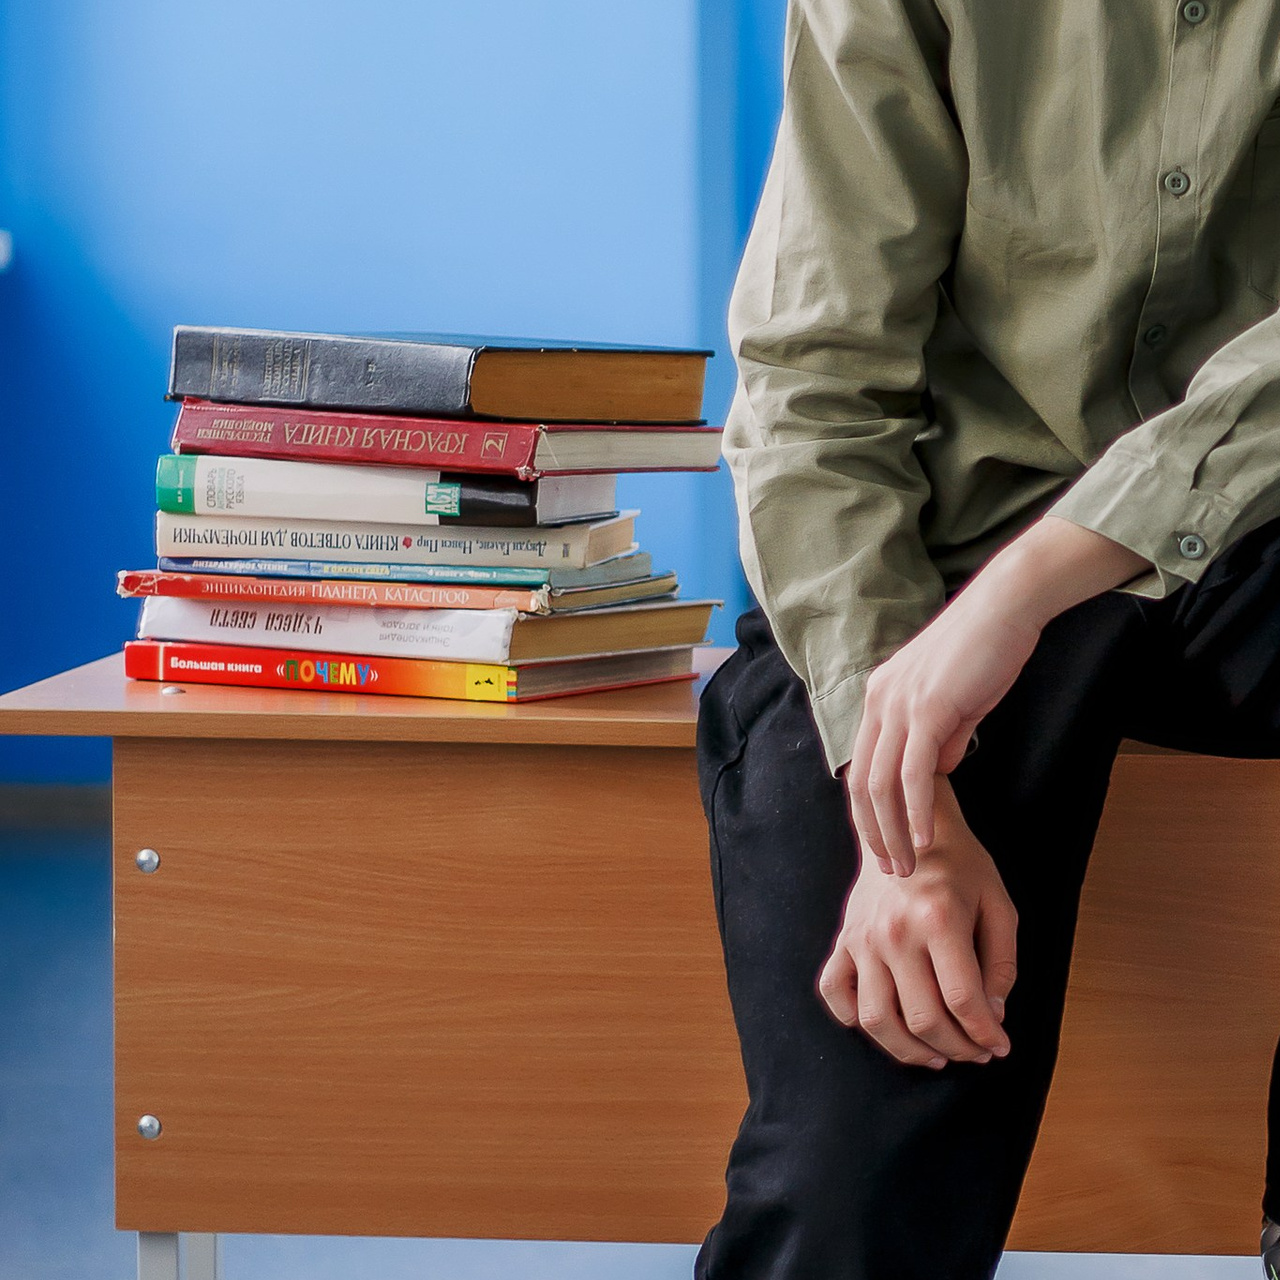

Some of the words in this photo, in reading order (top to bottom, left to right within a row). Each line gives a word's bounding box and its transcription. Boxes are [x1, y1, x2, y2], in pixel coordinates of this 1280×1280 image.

[196, 428, 272, 443] РЕСПУБЛИКИ
[283, 422, 359, 448] КНИГА
[359, 426, 469, 454] КРАСНАЯ
[485, 435, 503, 457] 2
[206, 467, 217, 508] СЛОВАРЬ
[226, 468, 236, 509] РУССКОГО
[236, 475, 245, 504] ЯЗЫКА
[427, 485, 452, 513] АСТ
[173, 527, 258, 547] ПОЧЕМУЧКИ
[261, 530, 288, 547] ДЛЯ
[290, 532, 352, 549] ОТВЕТОВ
[354, 534, 399, 551] КНИГА
[416, 535, 438, 553] Пир
[512, 541, 547, 557] Джуди
[192, 559, 257, 570] ЛИТЕРАТУРНОЕ
[258, 562, 289, 571] ЧТЕНИЕ
[201, 582, 306, 597] ЭНЦИКЛОПЕДИЯ
[311, 584, 378, 601] ПЛАНЕТА
[384, 588, 470, 604] КАТАСТРОФ
[380, 620, 421, 631] загадок
[378, 632, 451, 648] Энциклопедия
[170, 657, 225, 672] Большая
[227, 662, 263, 675] книга
[276, 659, 379, 686] «ПОЧЕМУ»
